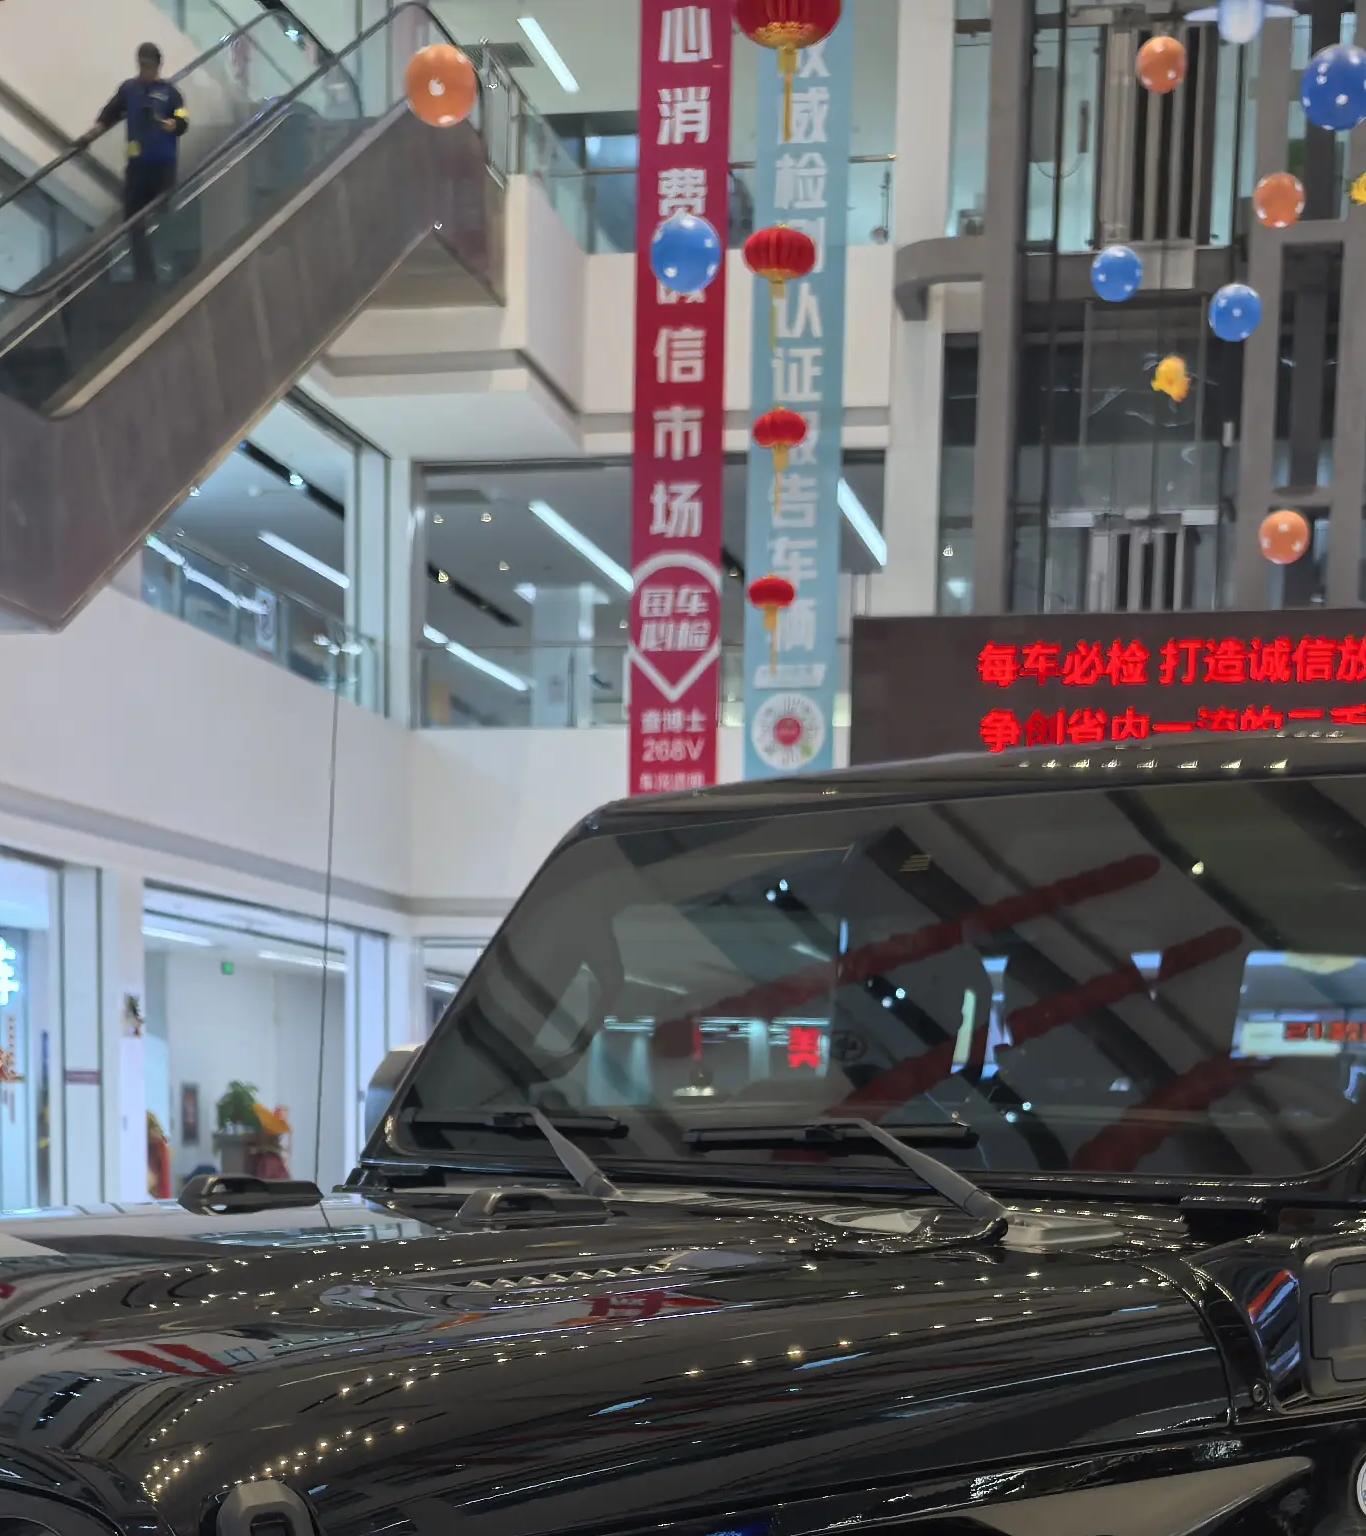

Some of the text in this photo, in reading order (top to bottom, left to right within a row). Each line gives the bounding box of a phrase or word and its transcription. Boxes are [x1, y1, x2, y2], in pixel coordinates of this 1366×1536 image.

[648, 5, 714, 538] 心消费信市场
[977, 640, 1150, 687] 每车必检
